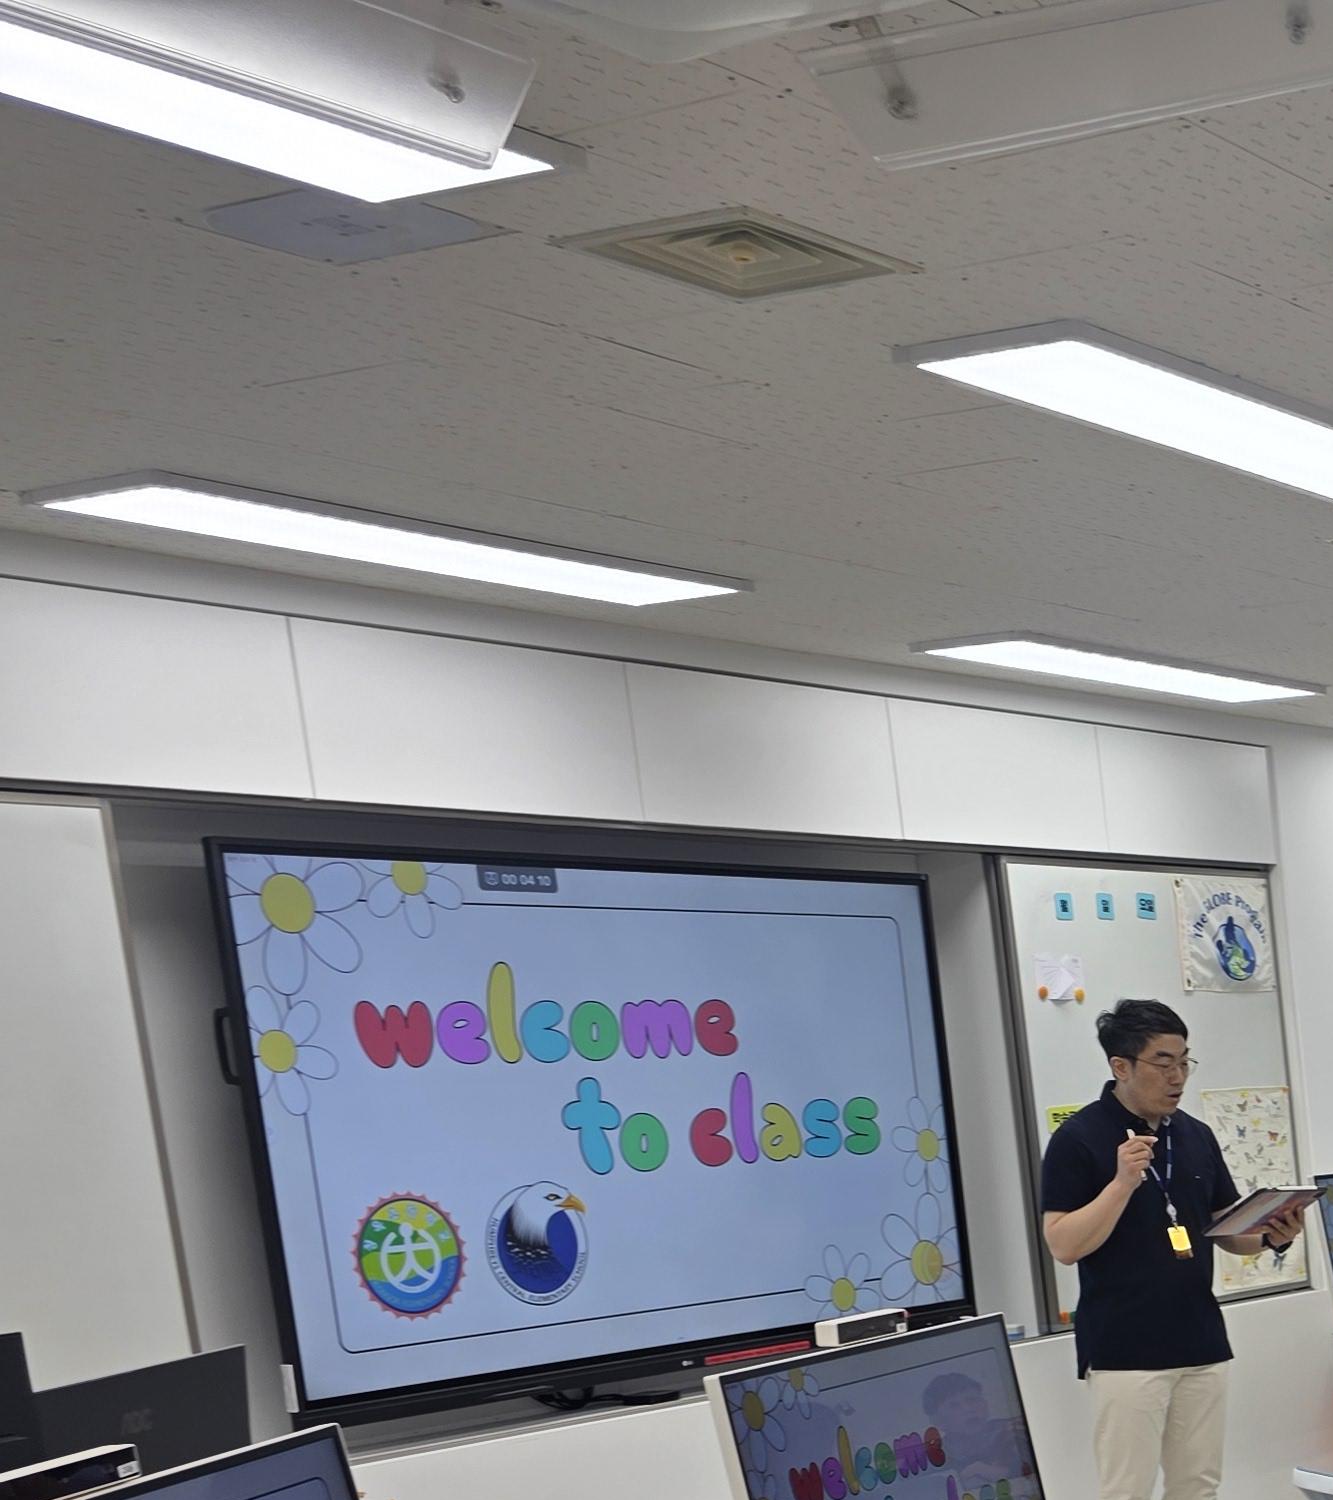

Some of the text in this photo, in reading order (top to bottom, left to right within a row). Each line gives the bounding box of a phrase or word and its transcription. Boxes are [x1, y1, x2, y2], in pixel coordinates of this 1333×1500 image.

[354, 961, 739, 1069] welcome
[562, 1072, 881, 1174] to class
